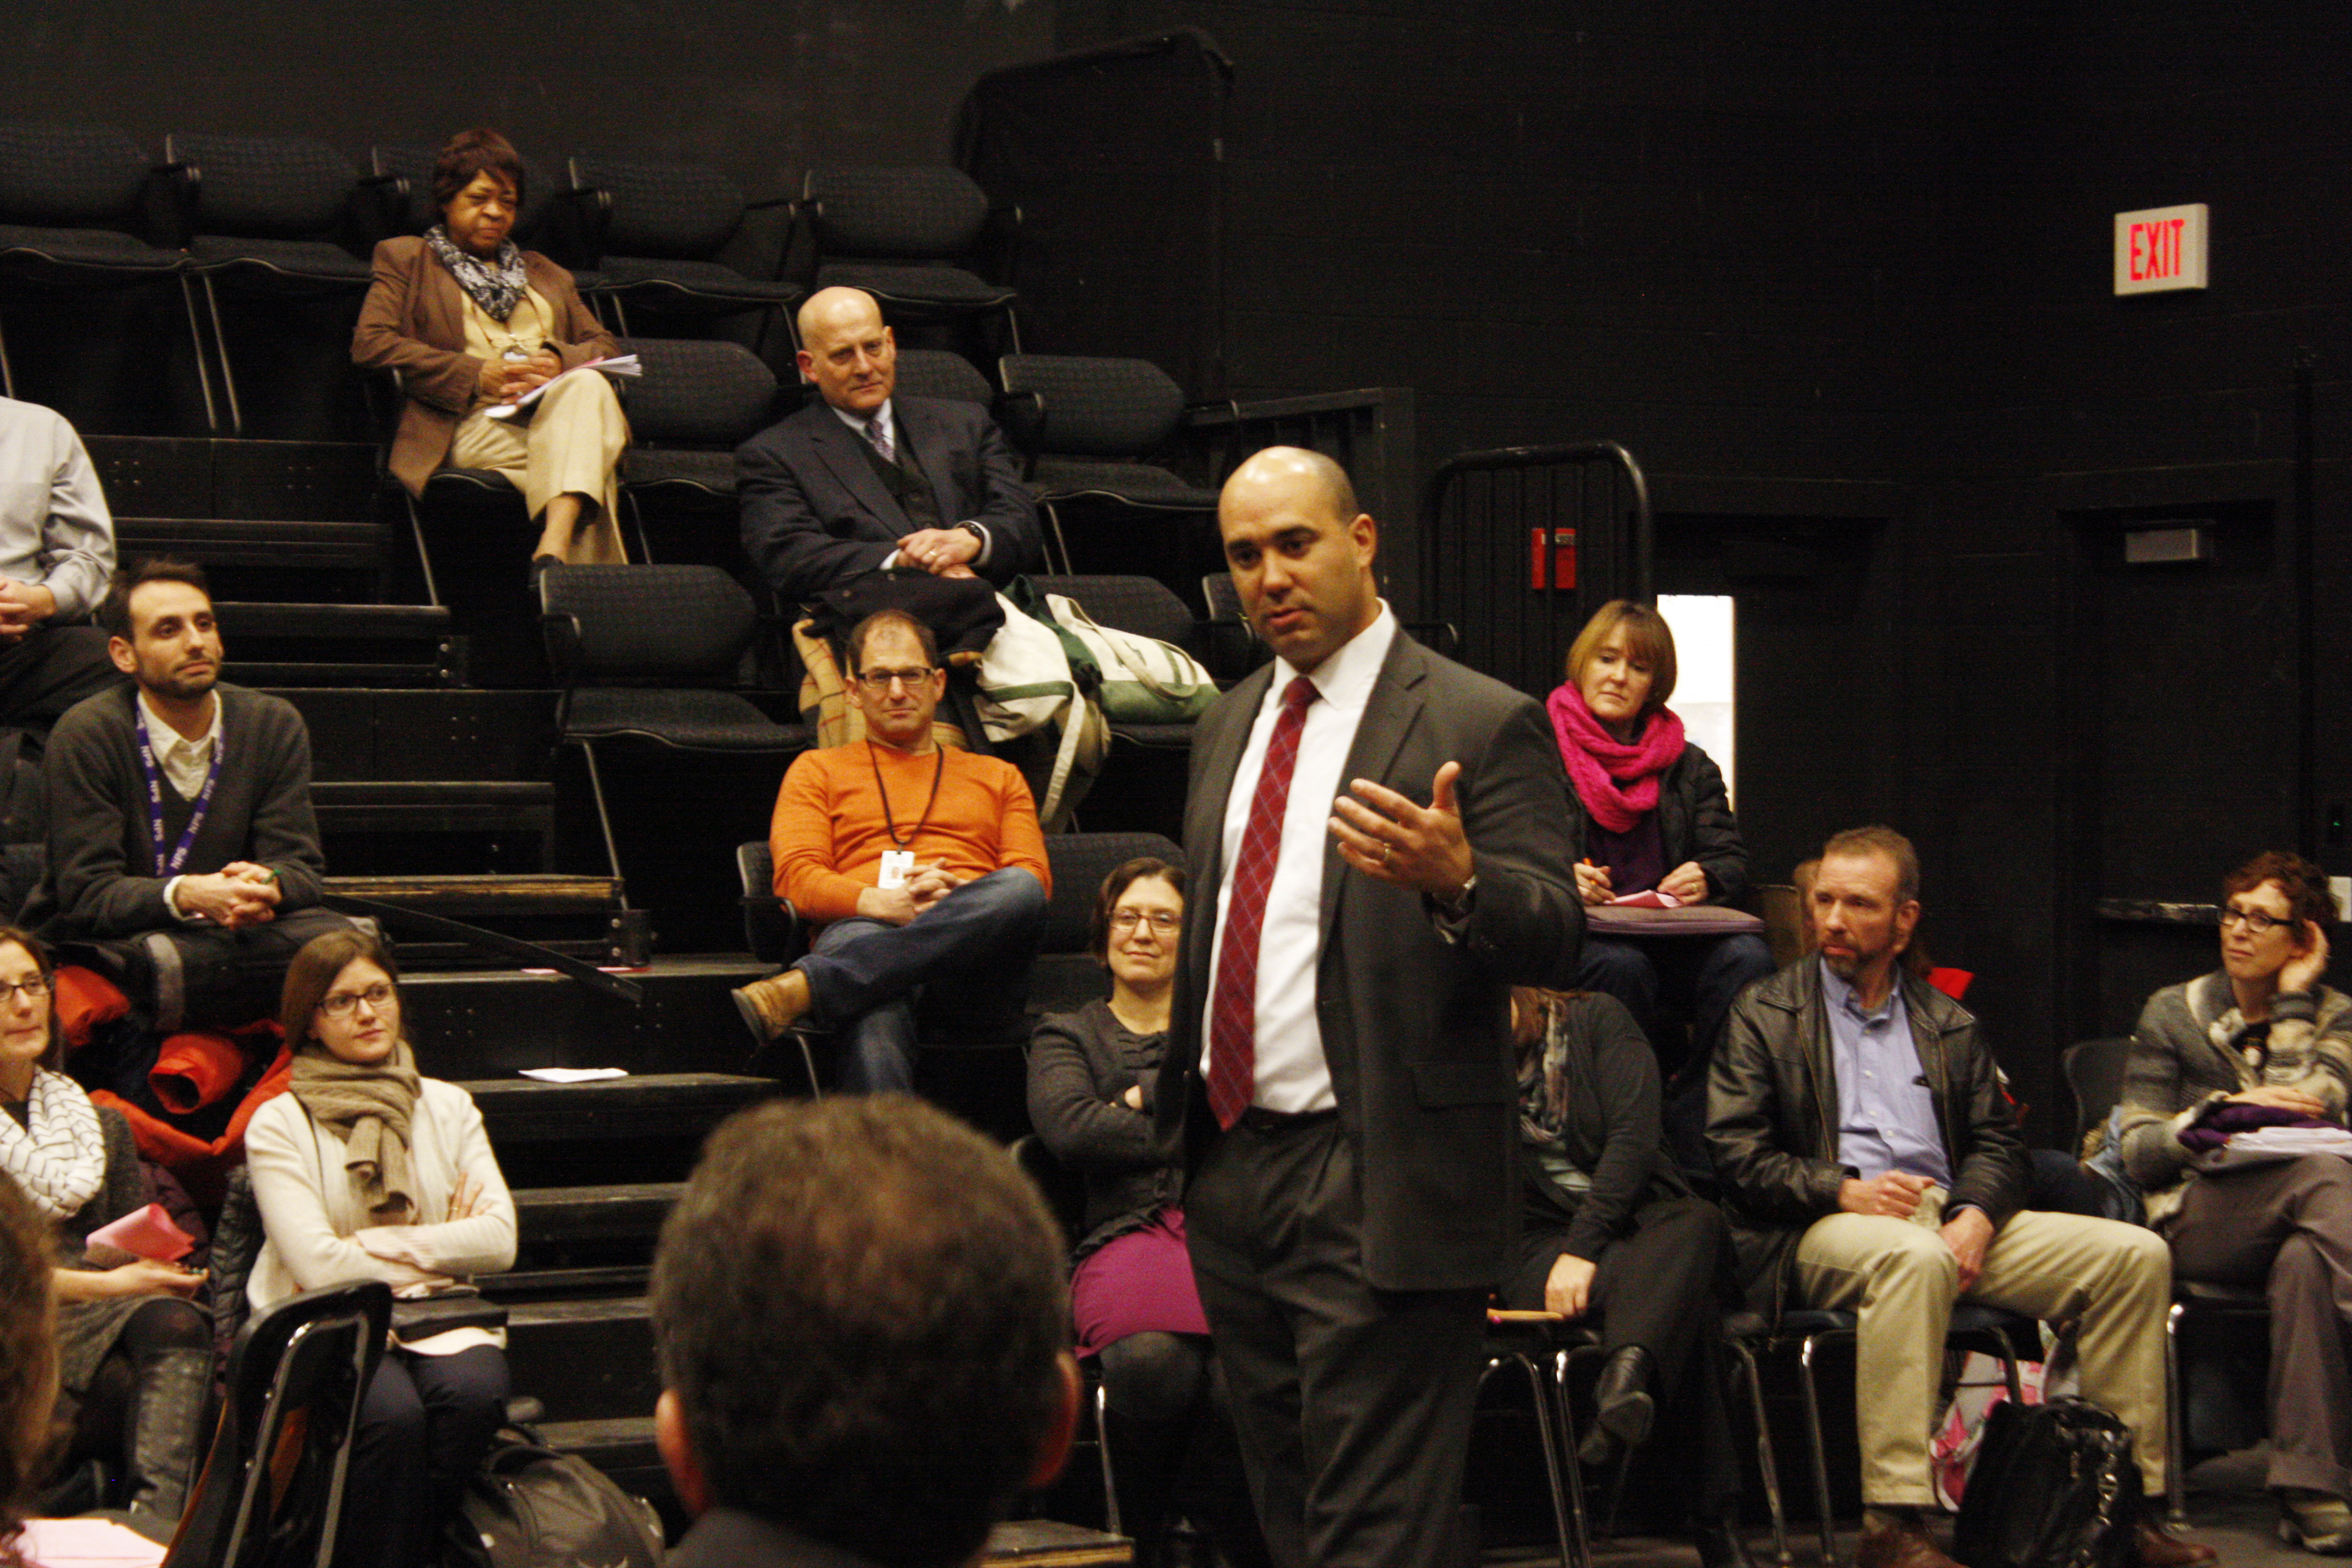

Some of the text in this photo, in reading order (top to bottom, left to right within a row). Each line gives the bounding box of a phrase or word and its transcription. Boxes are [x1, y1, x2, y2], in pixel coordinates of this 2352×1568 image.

[2129, 219, 2184, 280] EXIT
[149, 780, 160, 802] NPS
[153, 819, 164, 841] NPS
[170, 847, 187, 869] NPS
